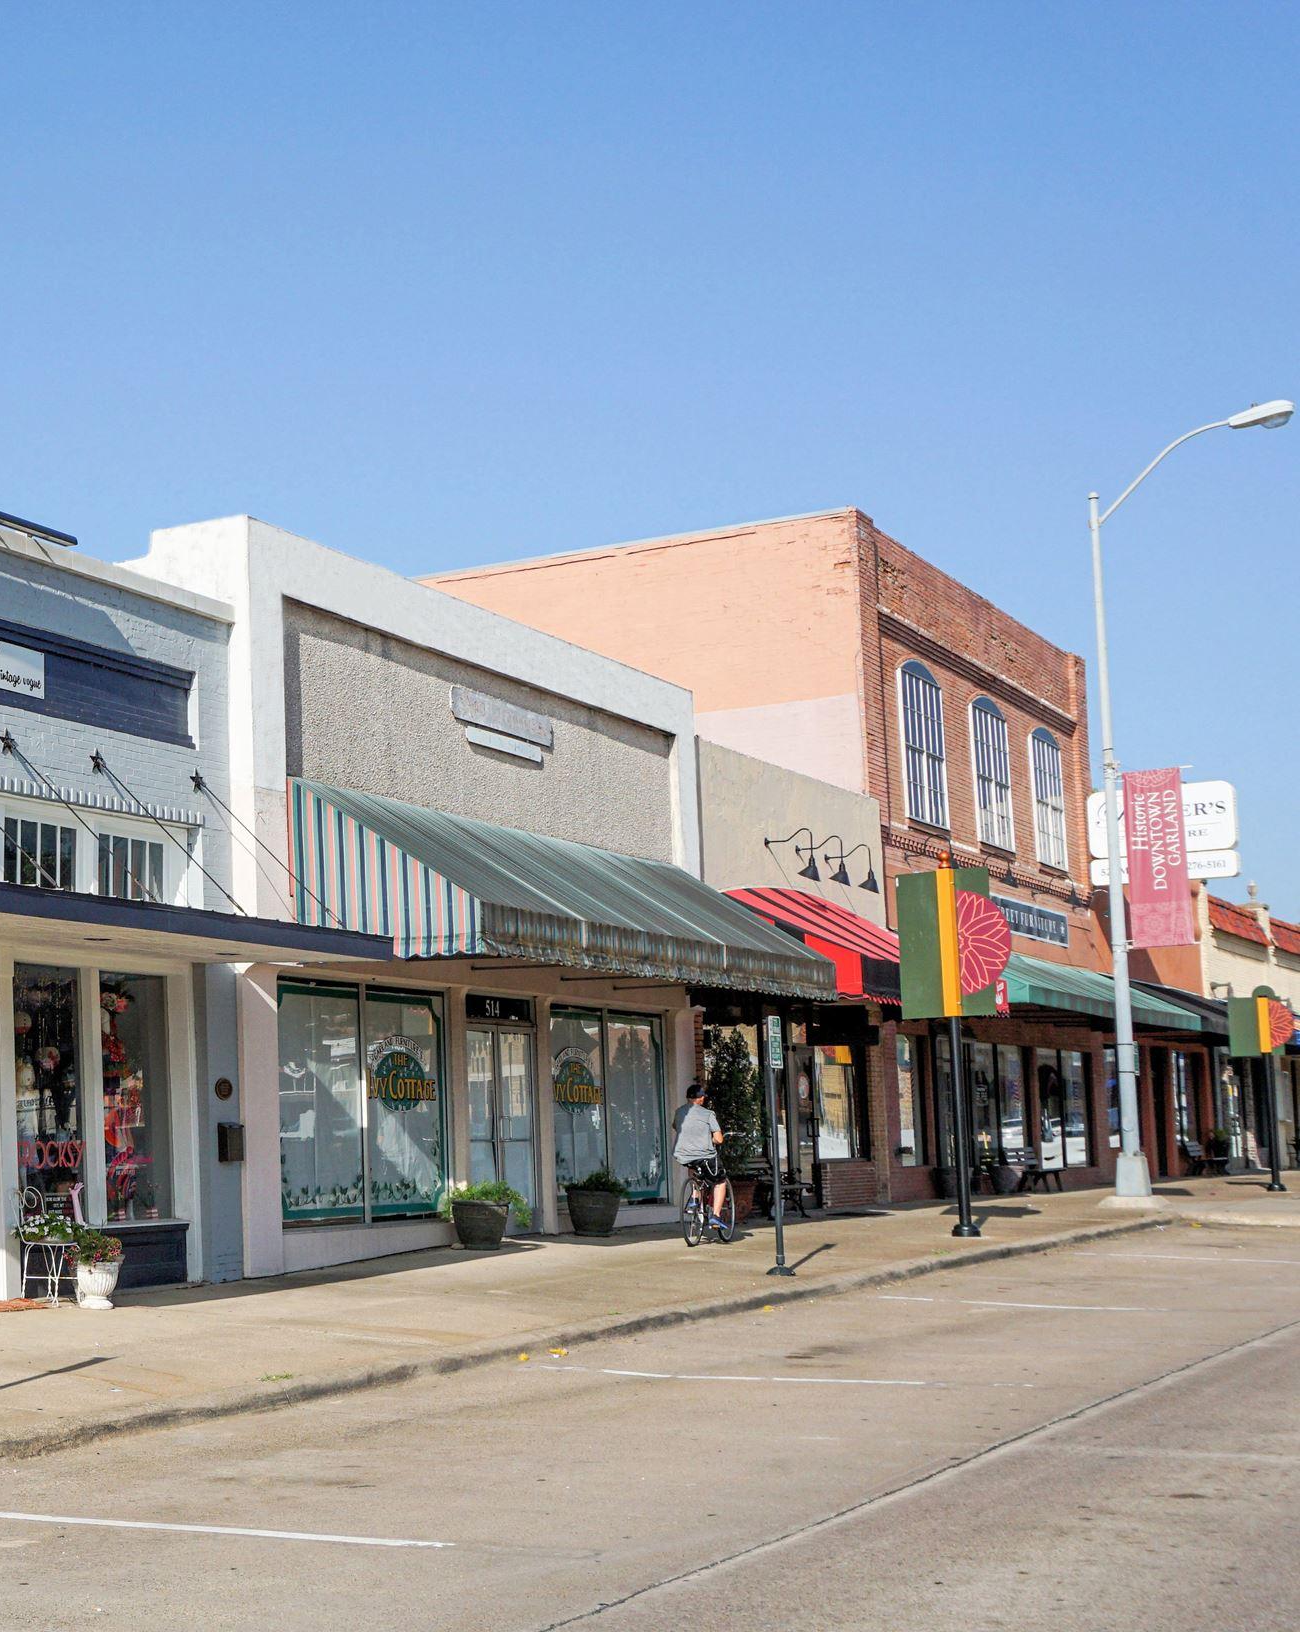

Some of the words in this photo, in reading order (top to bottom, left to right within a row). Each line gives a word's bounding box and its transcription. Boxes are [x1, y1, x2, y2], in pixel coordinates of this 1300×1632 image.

[22, 677, 42, 691] vogue
[1131, 793, 1149, 850] Historic
[1163, 789, 1181, 867] GARLAND
[1148, 792, 1168, 890] DOWNTOWN
[485, 999, 500, 1017] 514
[394, 1053, 409, 1067] THE
[366, 1067, 388, 1100] IVY
[389, 1070, 437, 1101] COTTAGE
[17, 1140, 86, 1169] ROCKSY
